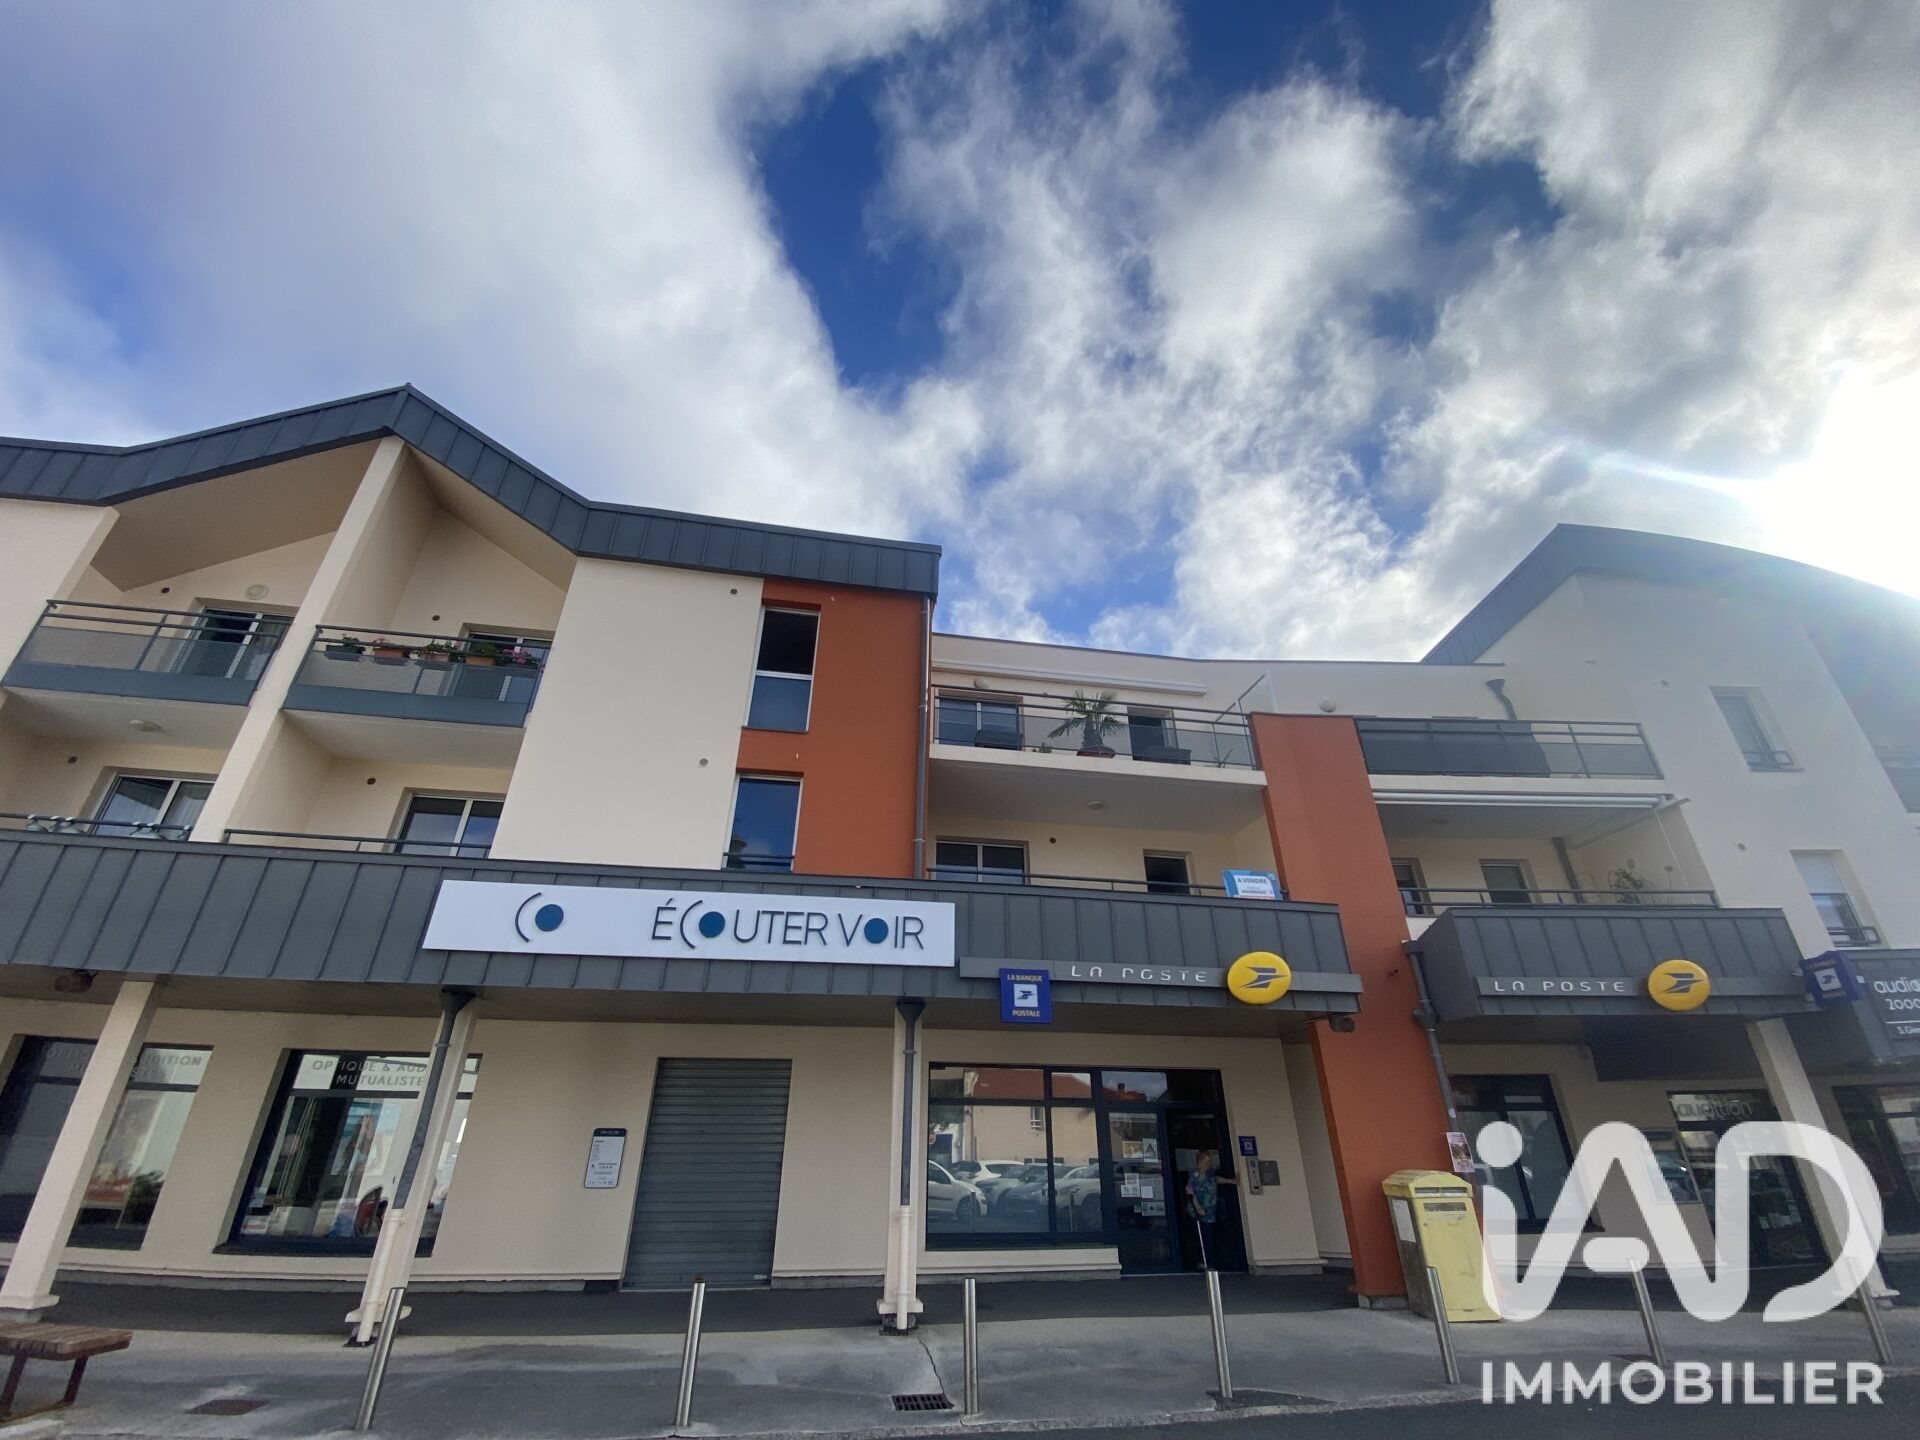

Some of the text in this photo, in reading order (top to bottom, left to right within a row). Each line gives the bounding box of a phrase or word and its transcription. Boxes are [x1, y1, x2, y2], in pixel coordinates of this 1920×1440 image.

[652, 898, 924, 949] ÉCOUTER VOIR
[1016, 974, 1043, 982] BANQUE
[1071, 965, 1207, 982] LA POSTE
[1494, 980, 1625, 992] LA POSTE
[1012, 1009, 1041, 1017] POSTALE
[312, 1060, 375, 1072] OPTIQUE
